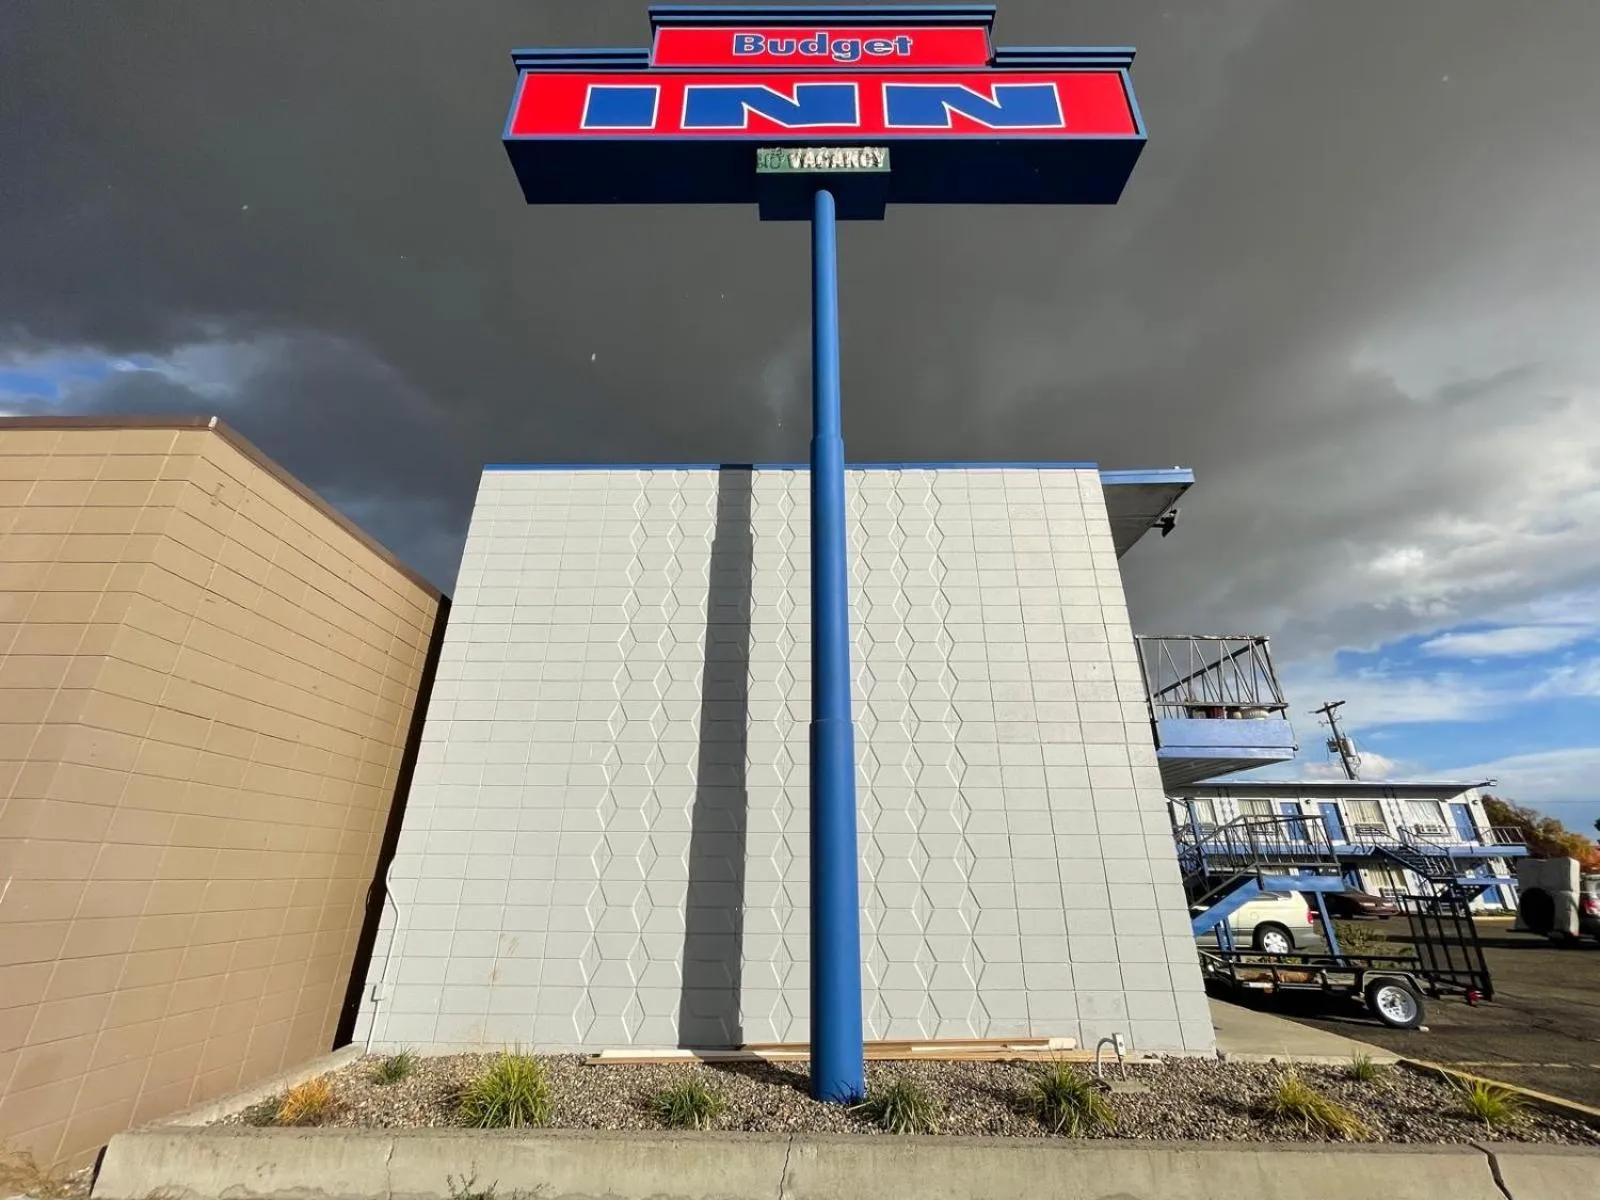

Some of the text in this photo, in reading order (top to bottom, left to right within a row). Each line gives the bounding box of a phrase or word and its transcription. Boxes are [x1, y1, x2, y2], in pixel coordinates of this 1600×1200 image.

[733, 32, 913, 62] Budget
[580, 82, 1066, 129] INN
[788, 146, 885, 169] VACANCY
